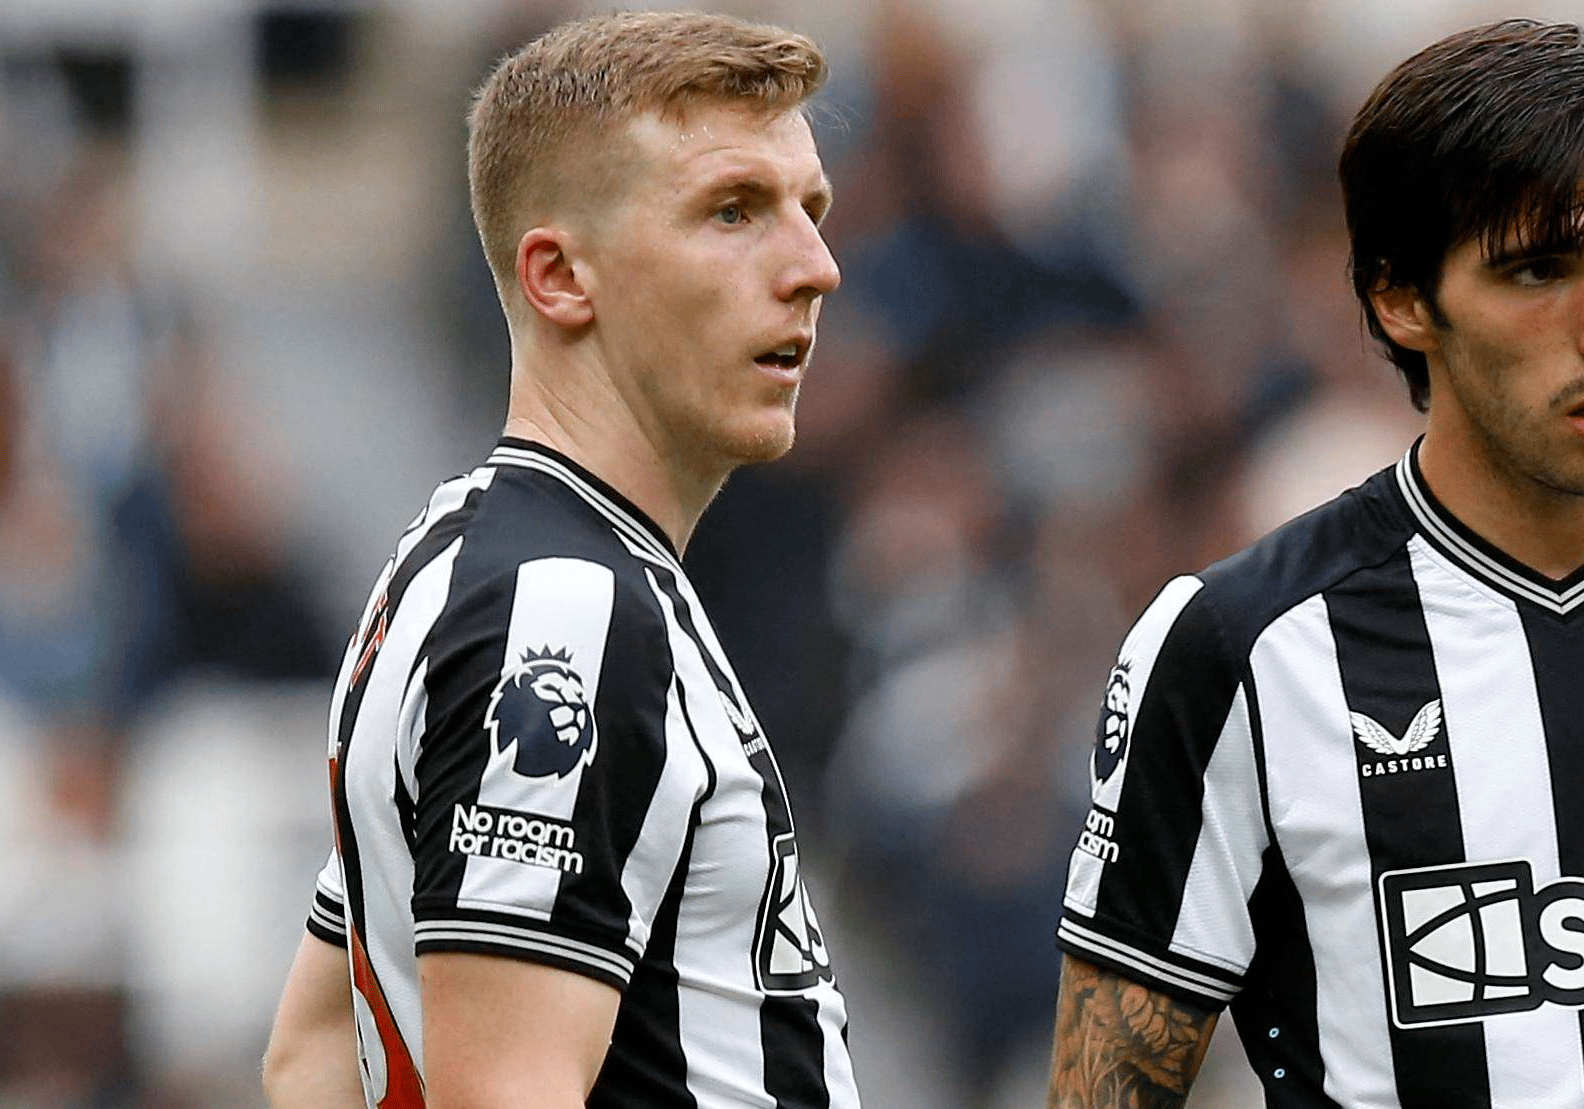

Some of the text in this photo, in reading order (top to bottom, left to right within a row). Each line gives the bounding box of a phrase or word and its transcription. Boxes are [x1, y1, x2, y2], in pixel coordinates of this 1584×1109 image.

[1361, 754, 1448, 778] CASTORE
[452, 803, 575, 848] No room
[449, 827, 584, 874] for racism
